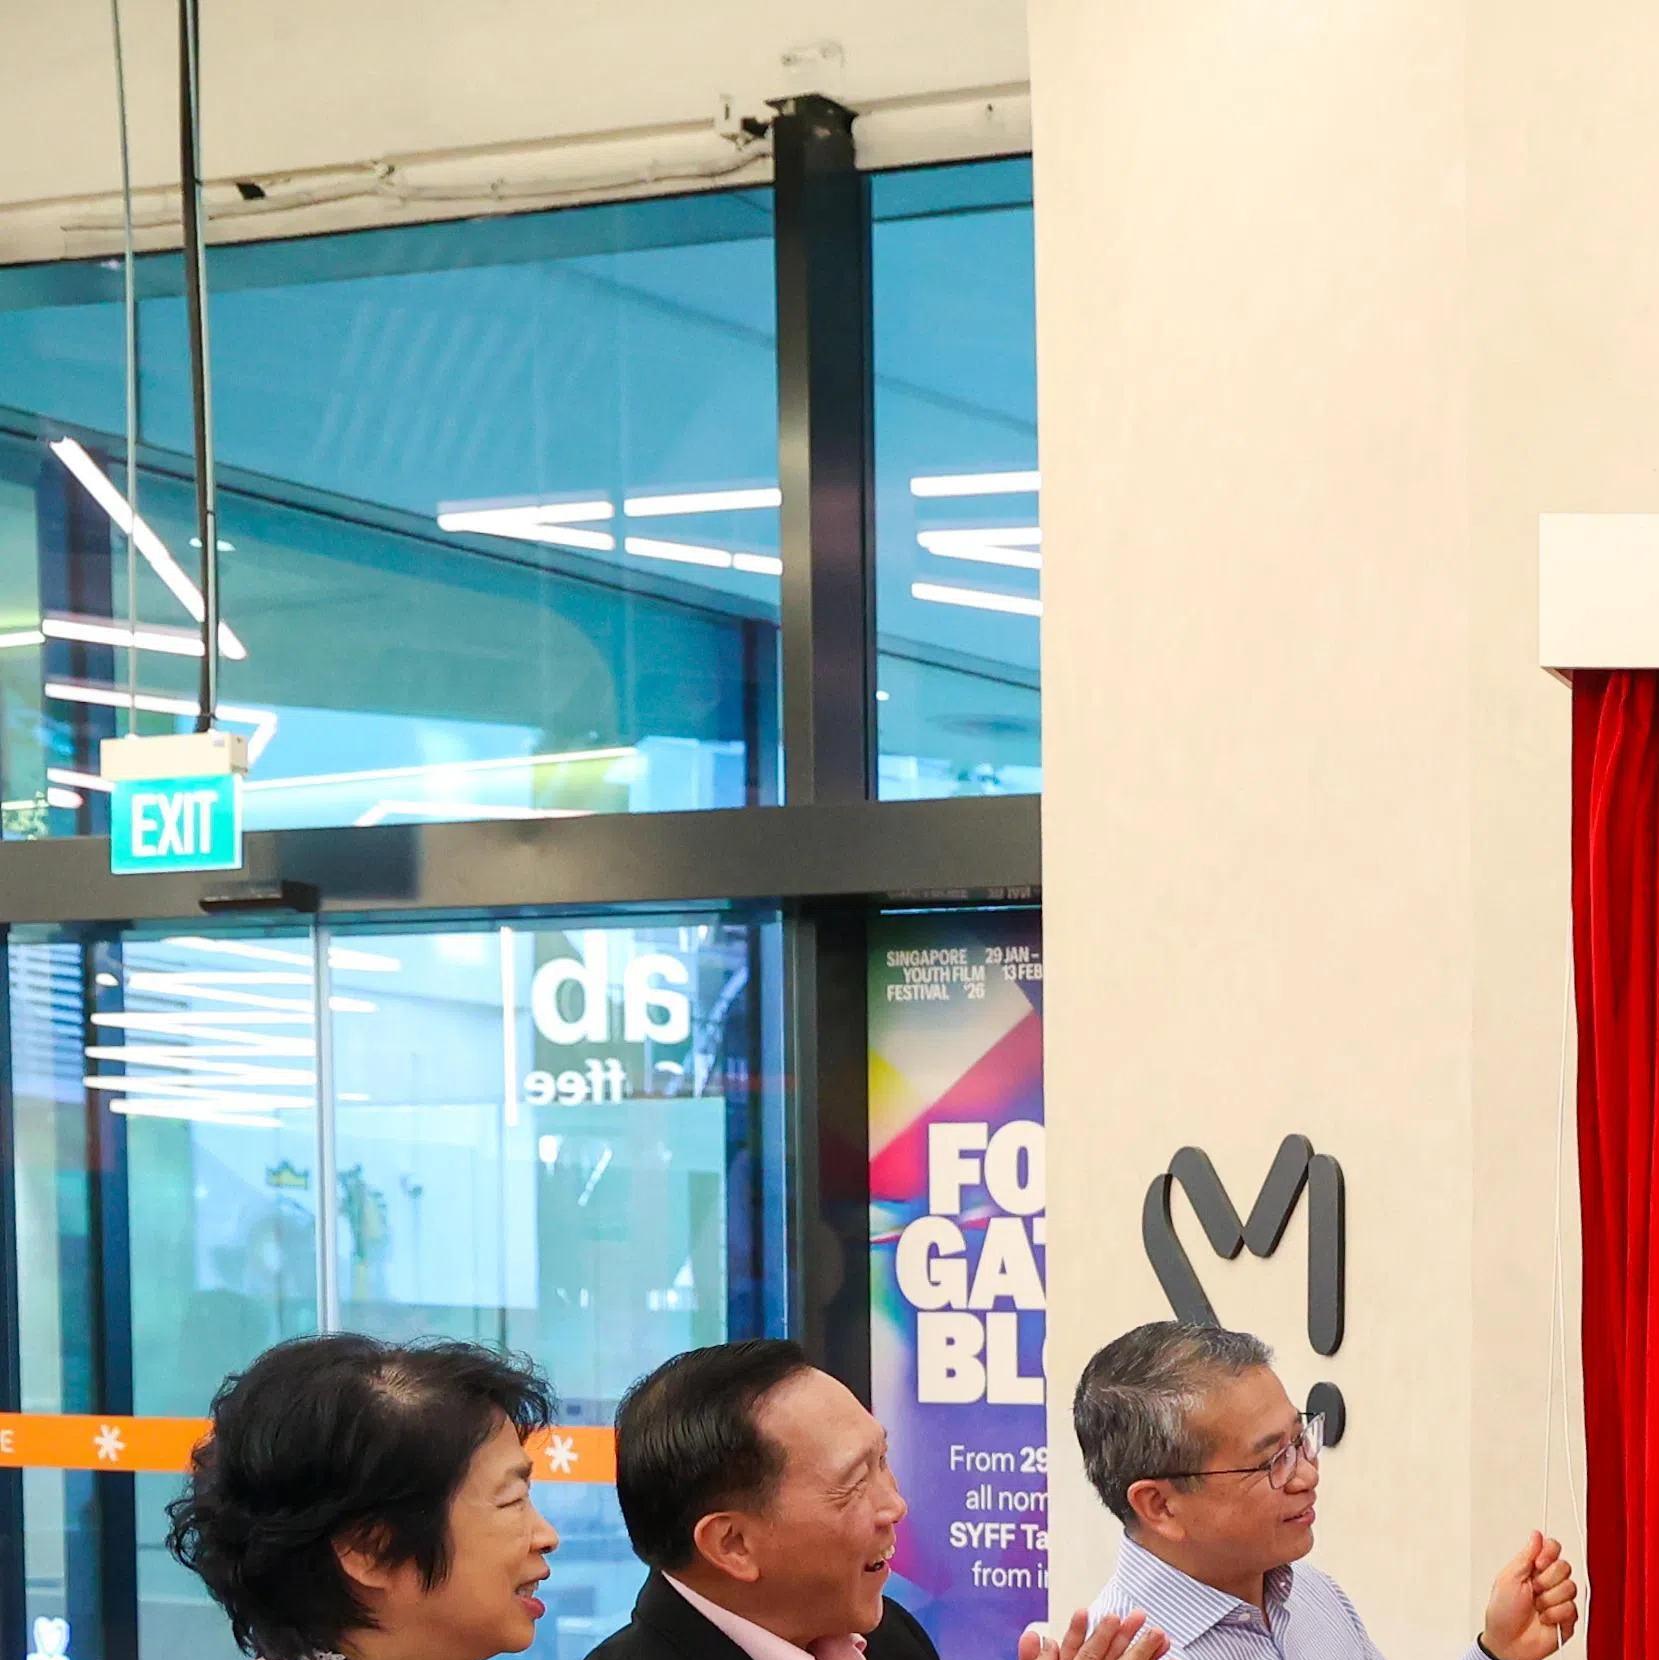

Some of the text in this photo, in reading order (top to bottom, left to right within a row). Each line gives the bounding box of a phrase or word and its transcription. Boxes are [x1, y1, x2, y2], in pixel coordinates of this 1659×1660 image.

[131, 790, 219, 857] EXIT
[886, 948, 968, 967] SINGAPORE
[985, 948, 1002, 964] 29
[1004, 946, 1029, 962] JAN
[903, 964, 1042, 984] YOUTH FILM 13 FEB
[887, 984, 949, 1001] FESTIVAL
[895, 1215, 1046, 1311] GA
[950, 1445, 1015, 1472] From
[965, 1484, 993, 1510] all
[950, 1522, 1016, 1549] SYFF
[972, 1560, 1031, 1588] from
